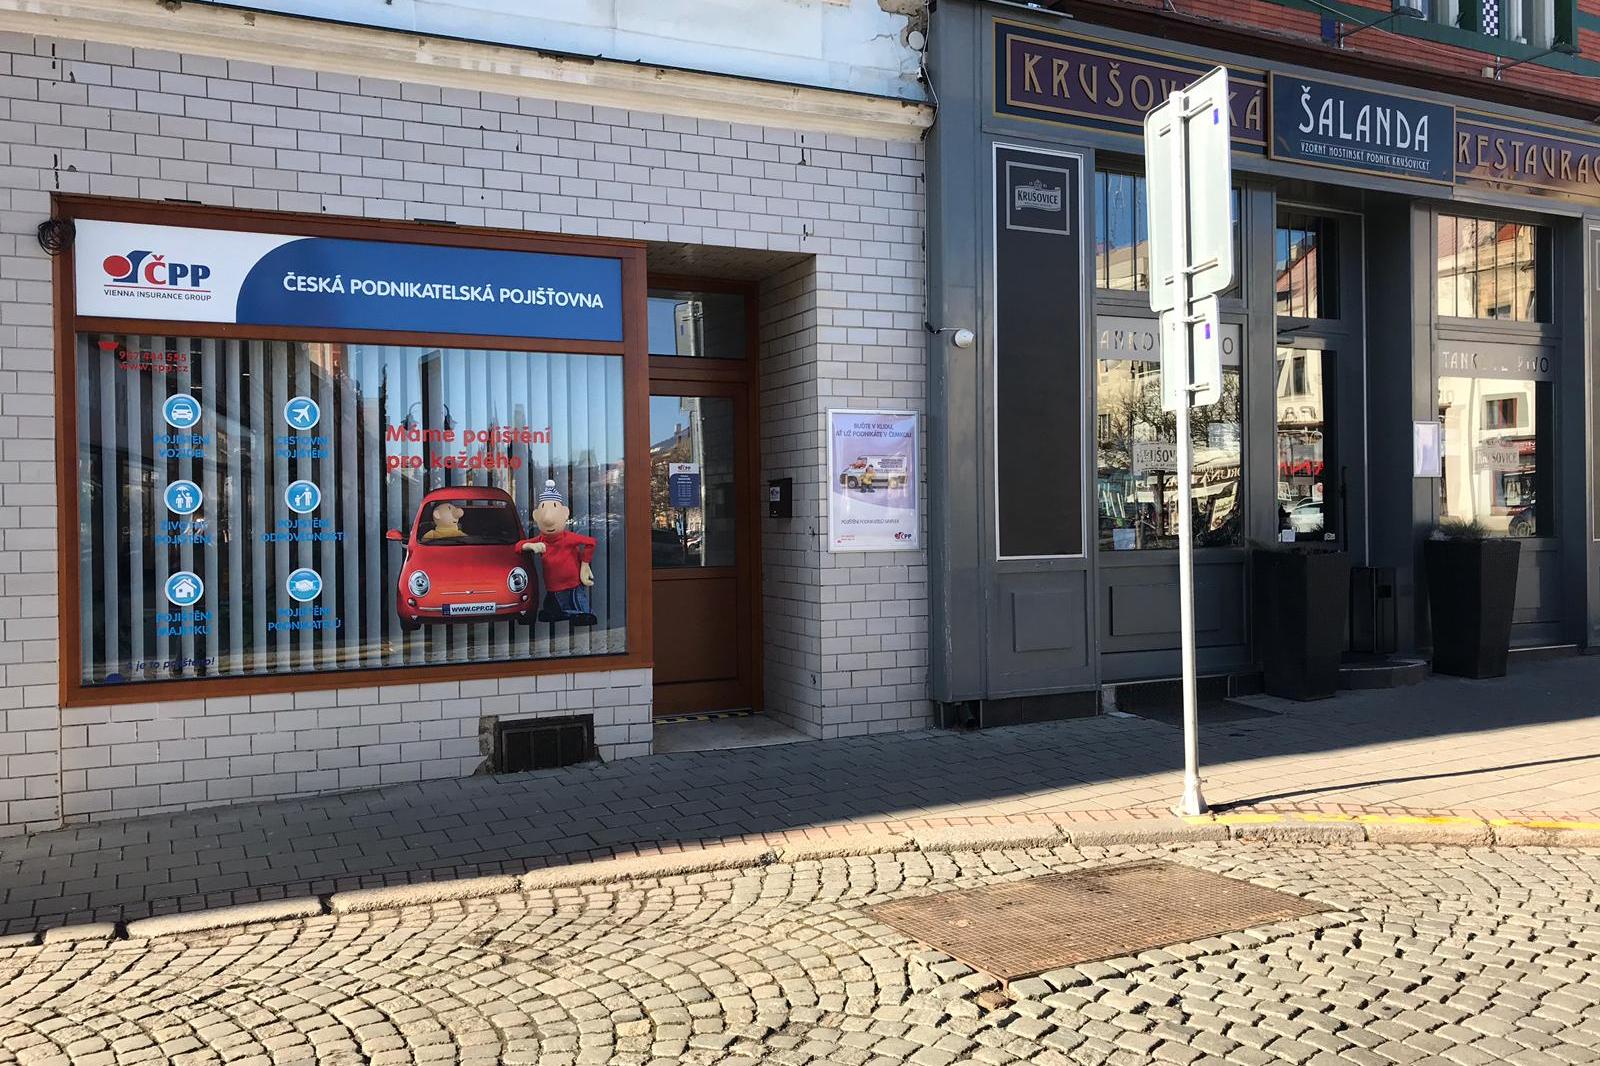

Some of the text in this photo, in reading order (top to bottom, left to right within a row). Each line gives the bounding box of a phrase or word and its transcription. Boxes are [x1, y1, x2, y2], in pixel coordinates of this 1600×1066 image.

[1023, 52, 1262, 131] KRUŠOVKÁ
[1298, 85, 1429, 153] ŠALANDA
[144, 254, 211, 287] ČPP
[103, 289, 212, 301] VIENNA INSURANCE GROUP
[283, 271, 604, 308] ČESKÁ PODNIKATELSKÁ POJIŠŤOVNA
[386, 424, 552, 447] Máme pojištění
[386, 450, 523, 474] pro každého
